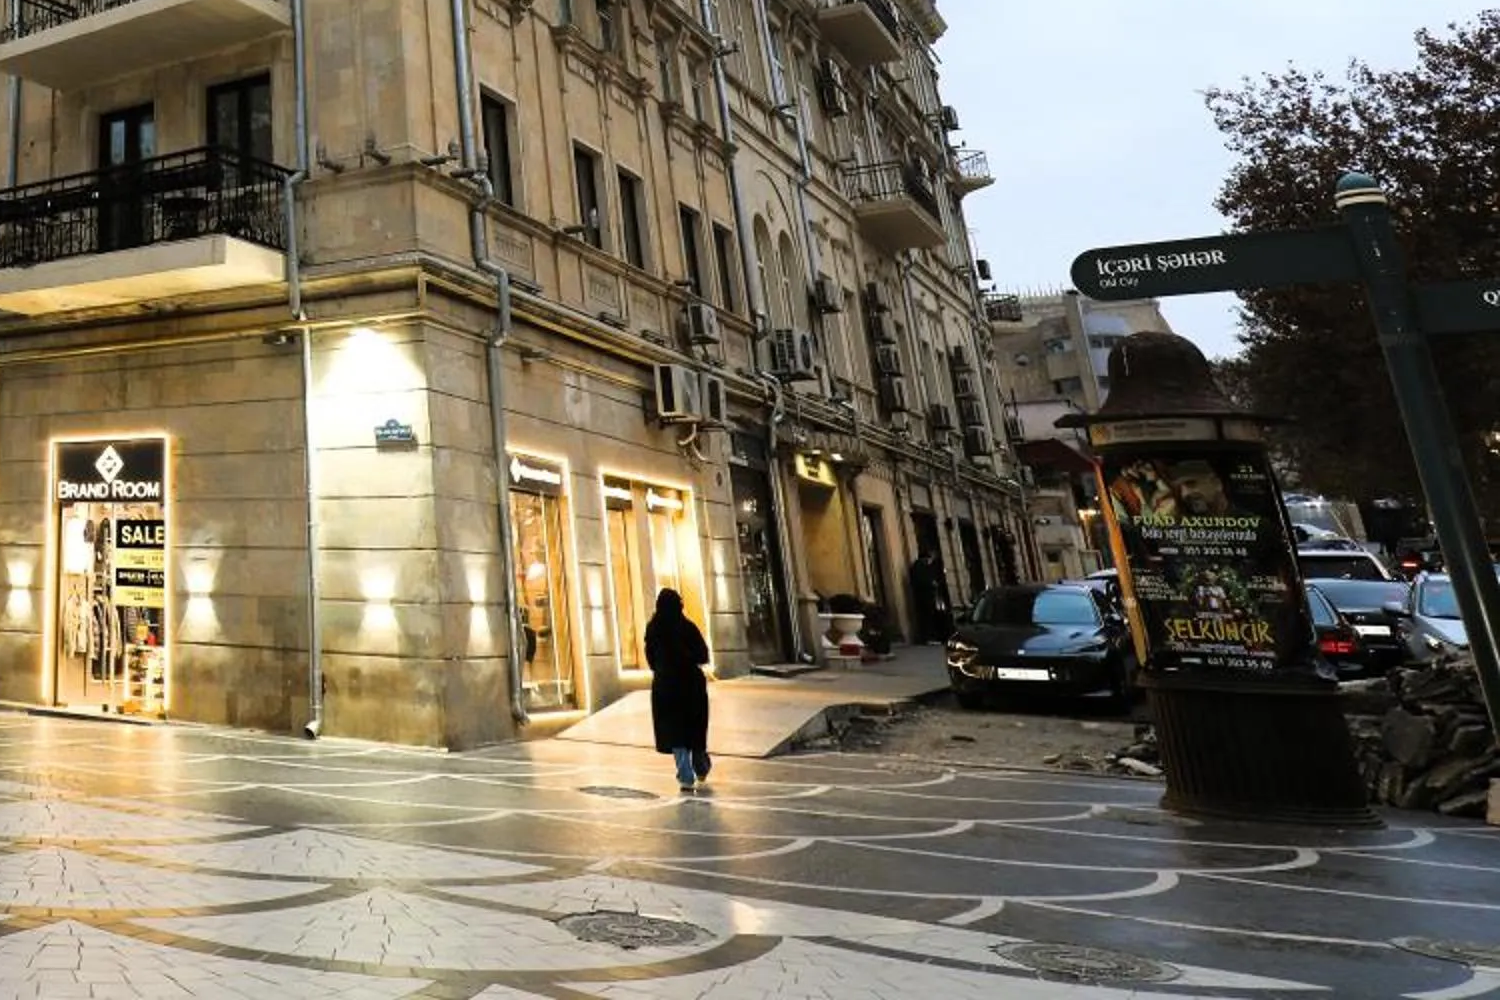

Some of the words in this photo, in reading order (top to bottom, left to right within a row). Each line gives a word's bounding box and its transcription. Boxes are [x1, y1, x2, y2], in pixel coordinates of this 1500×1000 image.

[1096, 253, 1152, 276] İÇƏRİ
[1156, 249, 1227, 272] ŞƏHƏR
[1099, 278, 1117, 288] Old
[1483, 289, 1500, 307] Q
[111, 480, 160, 498] ROOM
[1133, 515, 1175, 527] FUAD
[1180, 516, 1261, 528] AXUNDOV
[121, 525, 165, 544] SALE
